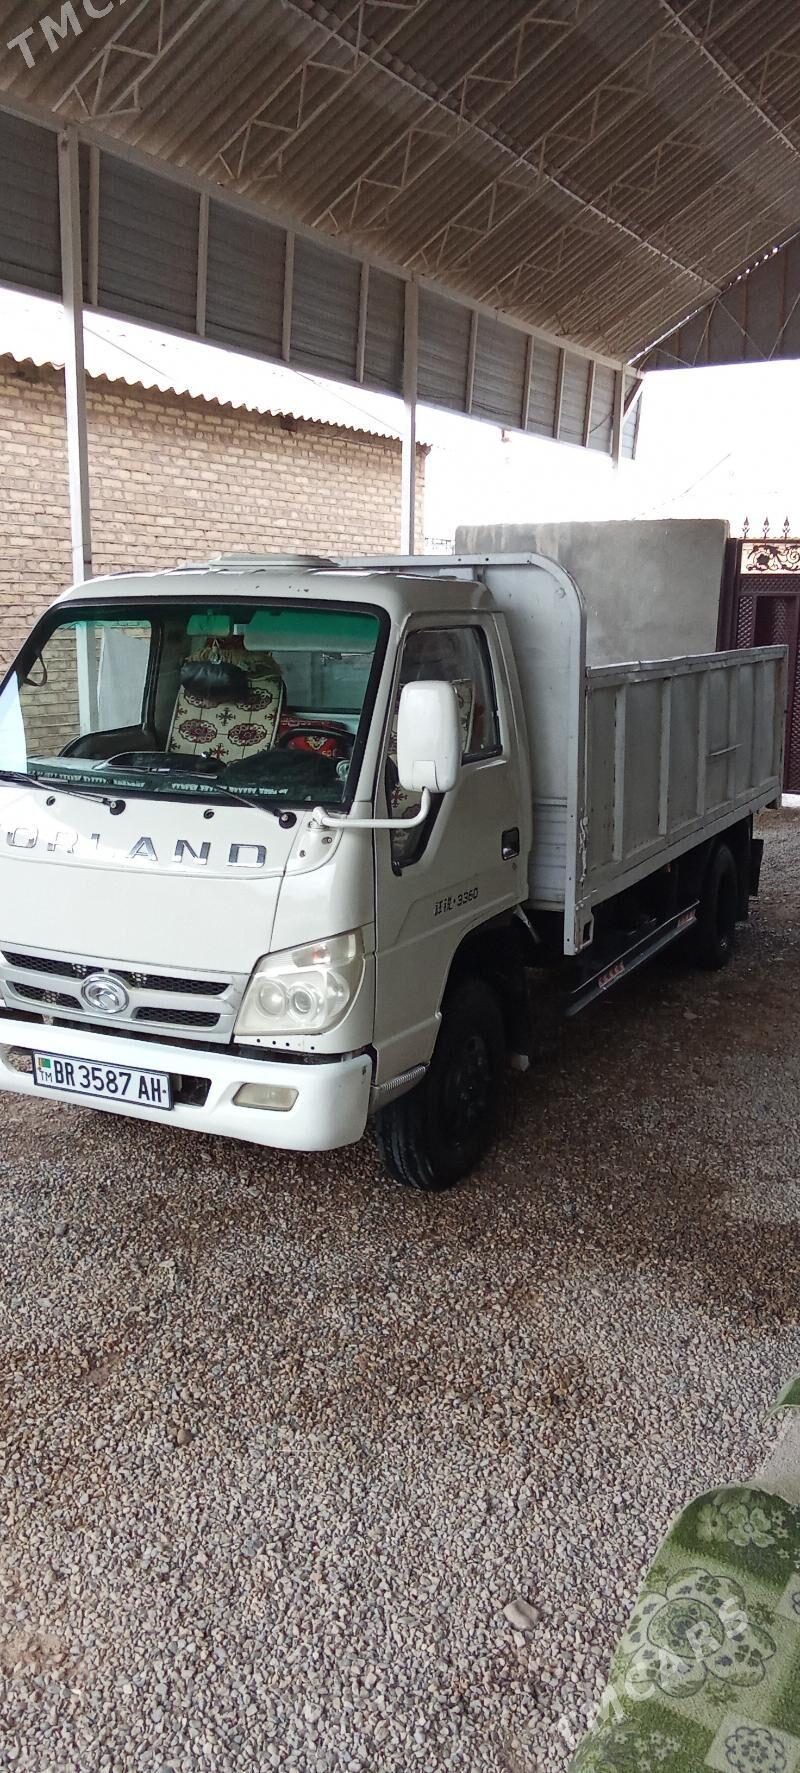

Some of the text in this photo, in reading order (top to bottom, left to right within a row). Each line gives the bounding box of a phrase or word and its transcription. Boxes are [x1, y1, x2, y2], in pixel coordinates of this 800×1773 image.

[39, 1068, 53, 1084] TM
[53, 1060, 162, 1103] BR 3587 AH
